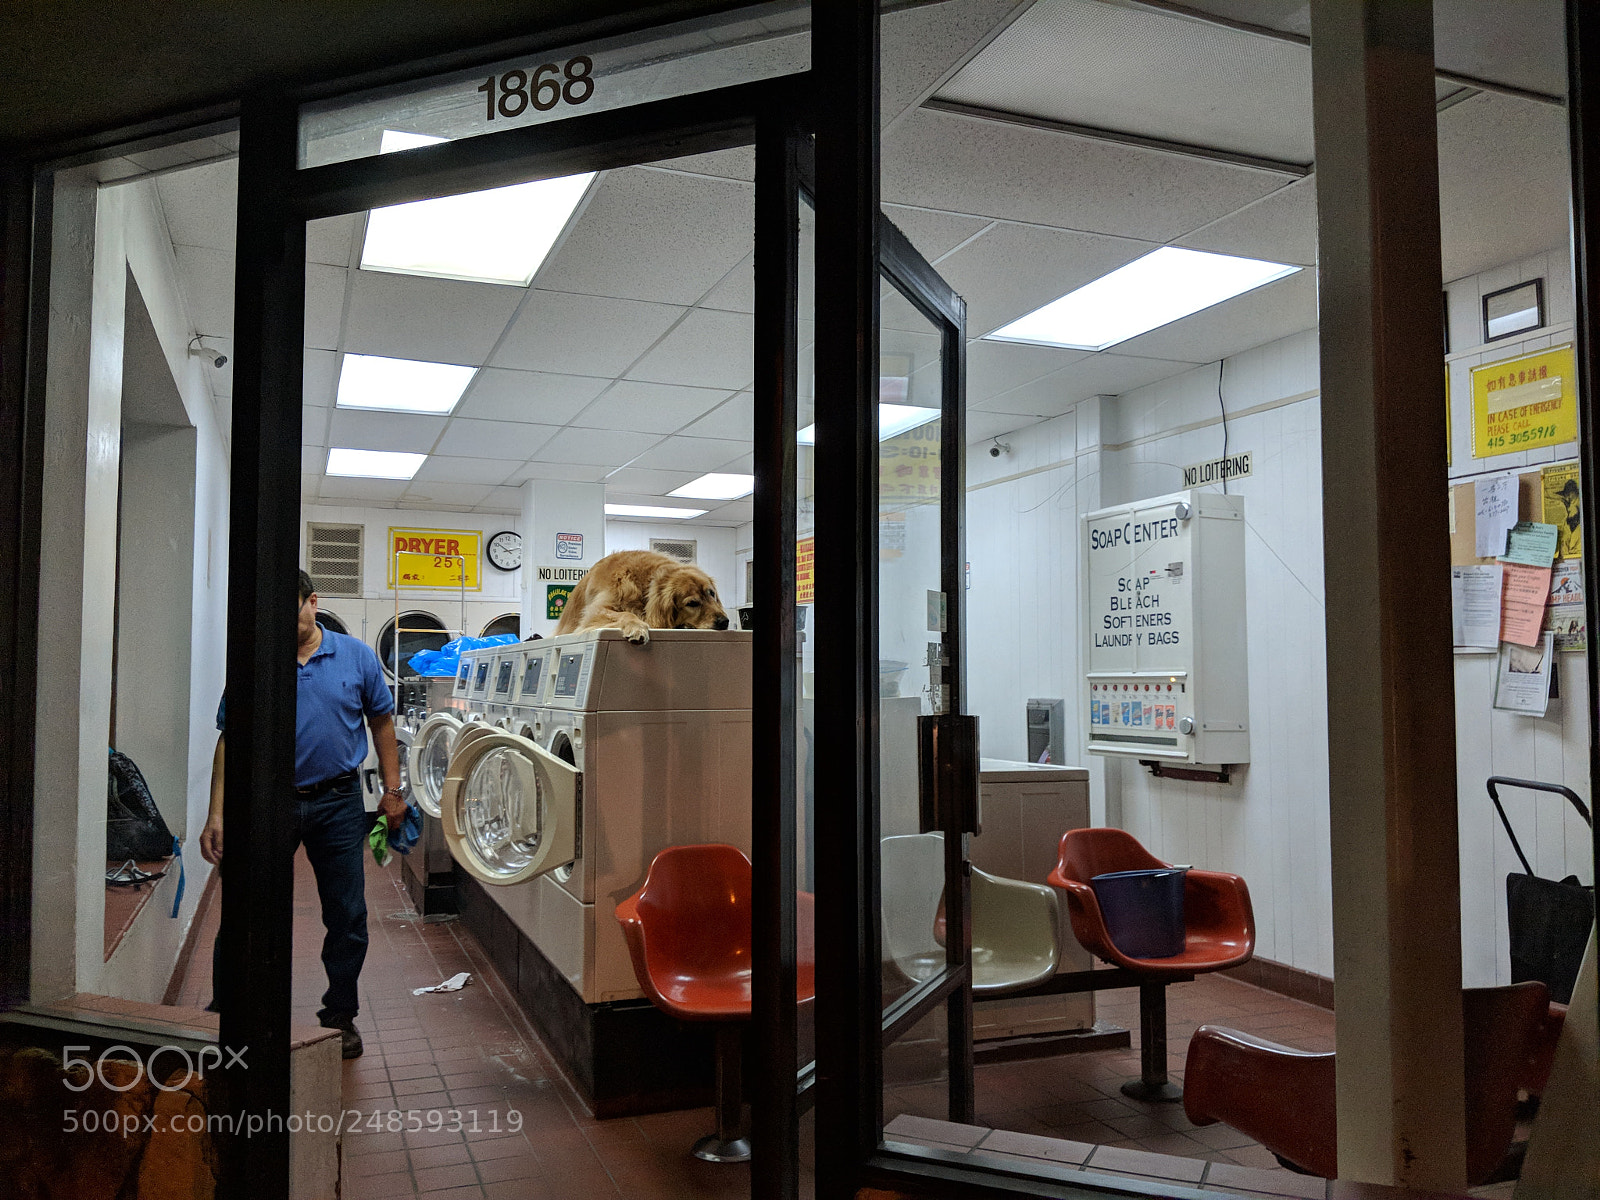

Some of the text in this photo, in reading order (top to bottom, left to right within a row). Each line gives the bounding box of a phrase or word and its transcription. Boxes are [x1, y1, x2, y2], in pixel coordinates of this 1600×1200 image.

[478, 55, 595, 121] 1868
[1488, 413, 1495, 425] IN
[1498, 408, 1517, 422] CASE
[1520, 407, 1527, 417] OF
[1488, 420, 1531, 437] PLEASE CALL
[1487, 437, 1505, 448] 415
[1184, 455, 1249, 486] NO LOITERING
[1091, 518, 1178, 550] SOAP CENTER
[395, 537, 460, 556] DRYER
[539, 568, 551, 580] NO
[1118, 577, 1150, 592] SOAP
[1111, 595, 1159, 611] BLEACH
[1103, 612, 1171, 629] SOFTENERS
[1095, 631, 1179, 647] LAUNDRY BAGS
